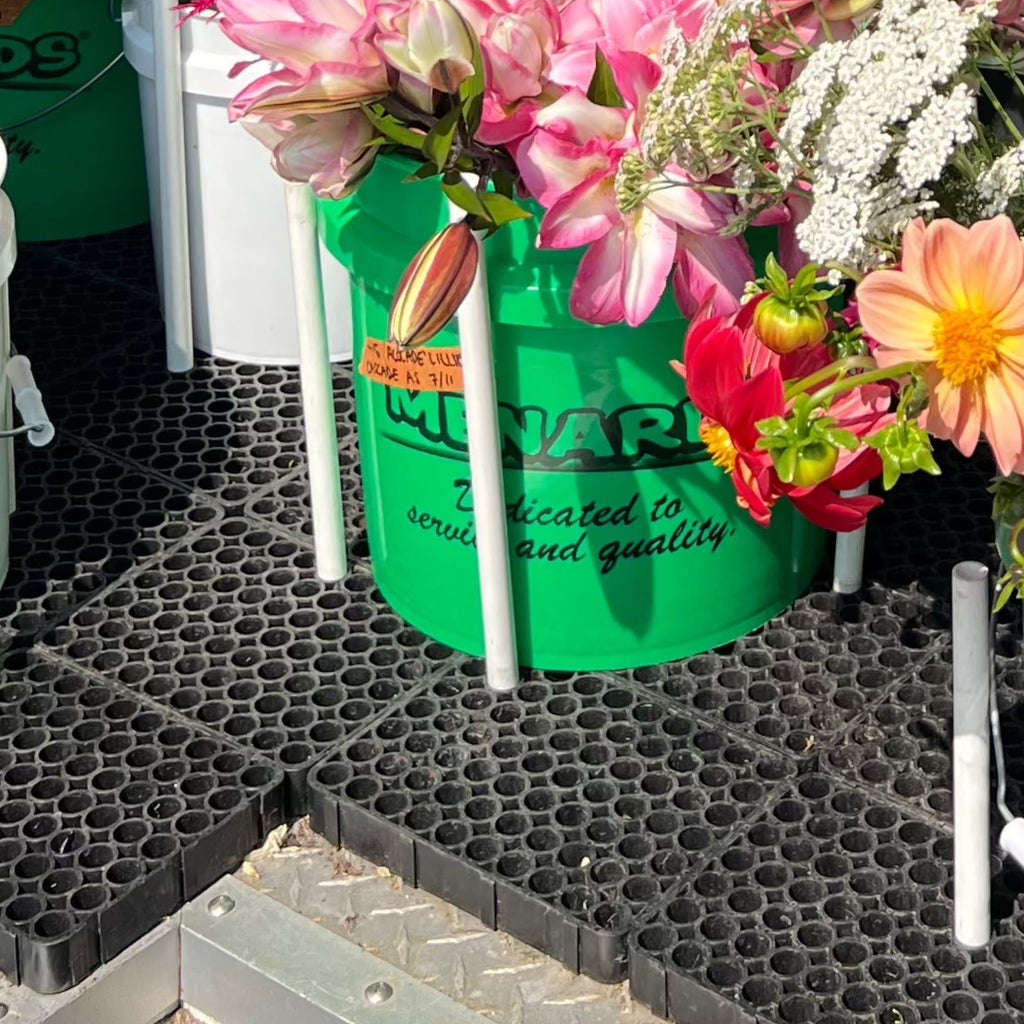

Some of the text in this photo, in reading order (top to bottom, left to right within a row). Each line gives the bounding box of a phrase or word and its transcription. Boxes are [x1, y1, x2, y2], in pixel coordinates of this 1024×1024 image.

[651, 494, 684, 520] to
[407, 504, 736, 574] servi and quality.
